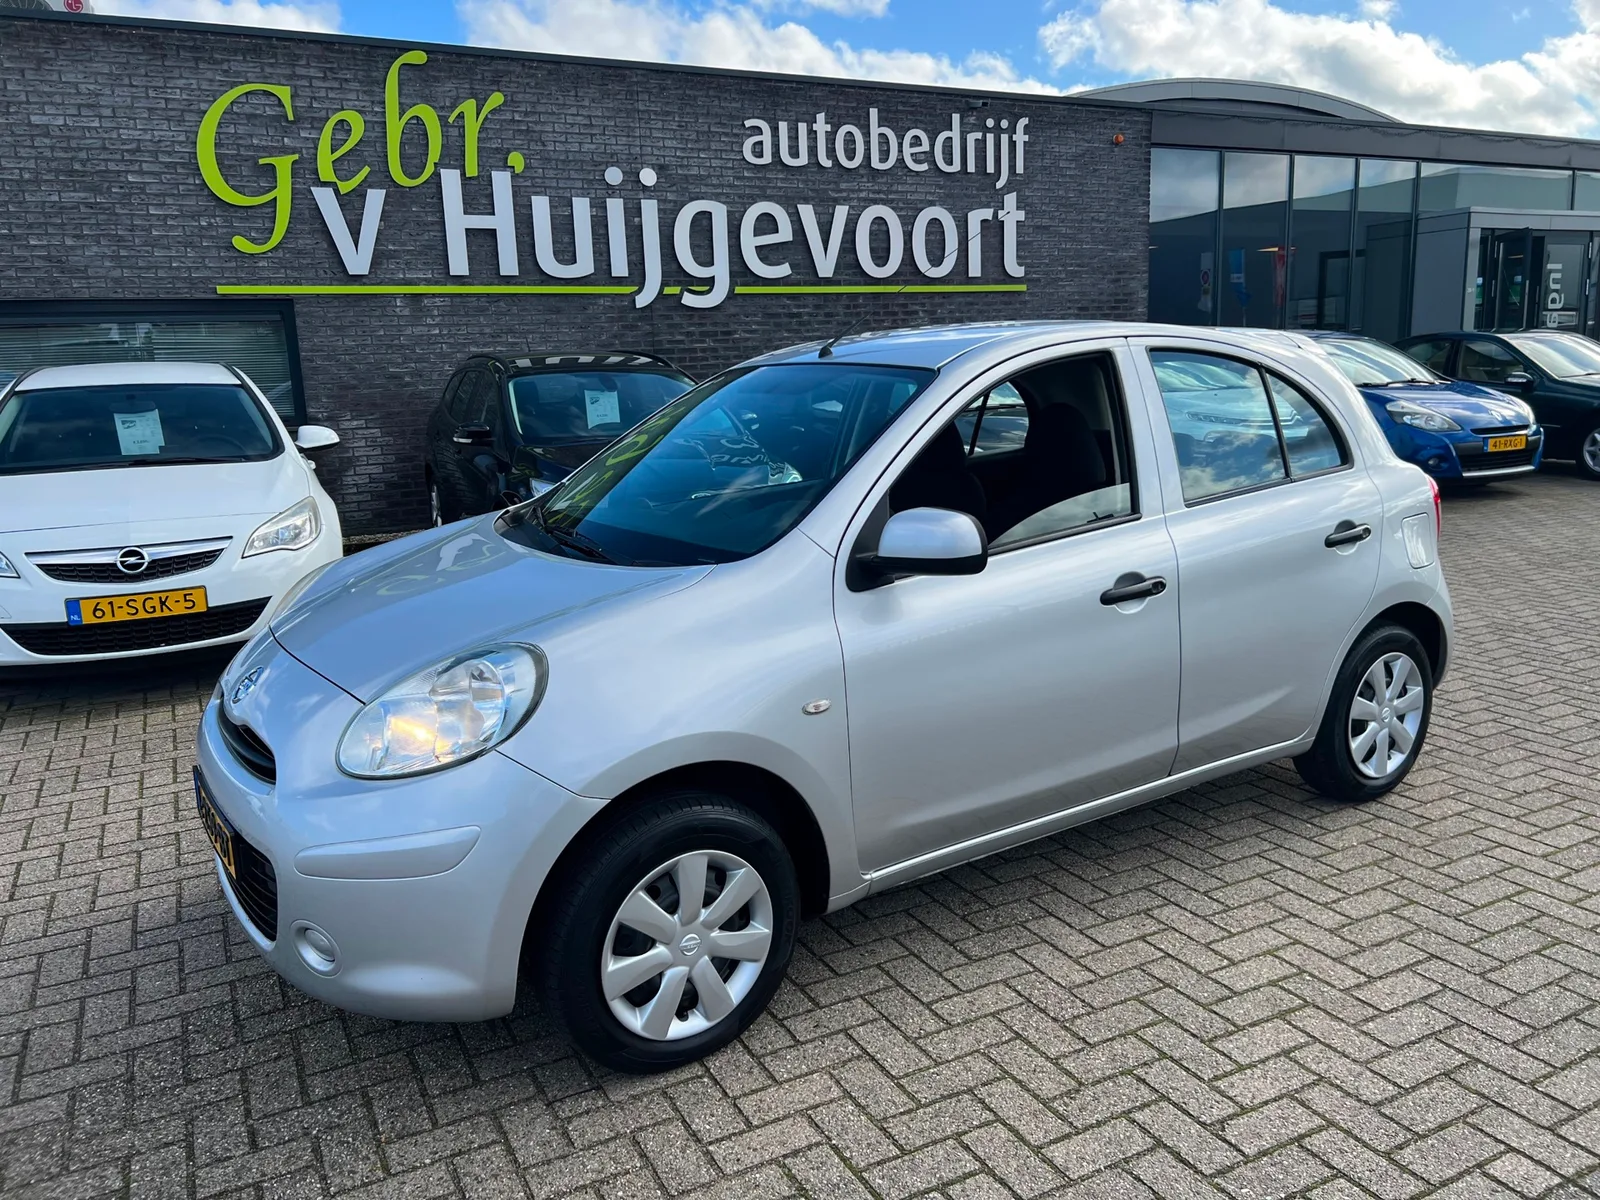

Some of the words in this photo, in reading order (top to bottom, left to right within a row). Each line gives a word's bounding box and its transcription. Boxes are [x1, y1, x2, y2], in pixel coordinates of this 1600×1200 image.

[195, 50, 525, 254] Gebr.
[742, 107, 1029, 189] autobedrijf
[310, 186, 386, 275] v
[440, 166, 1025, 308] Huijgevoort
[1492, 438, 1523, 449] 41-RXG-1
[92, 592, 196, 619] 61-SGK-5
